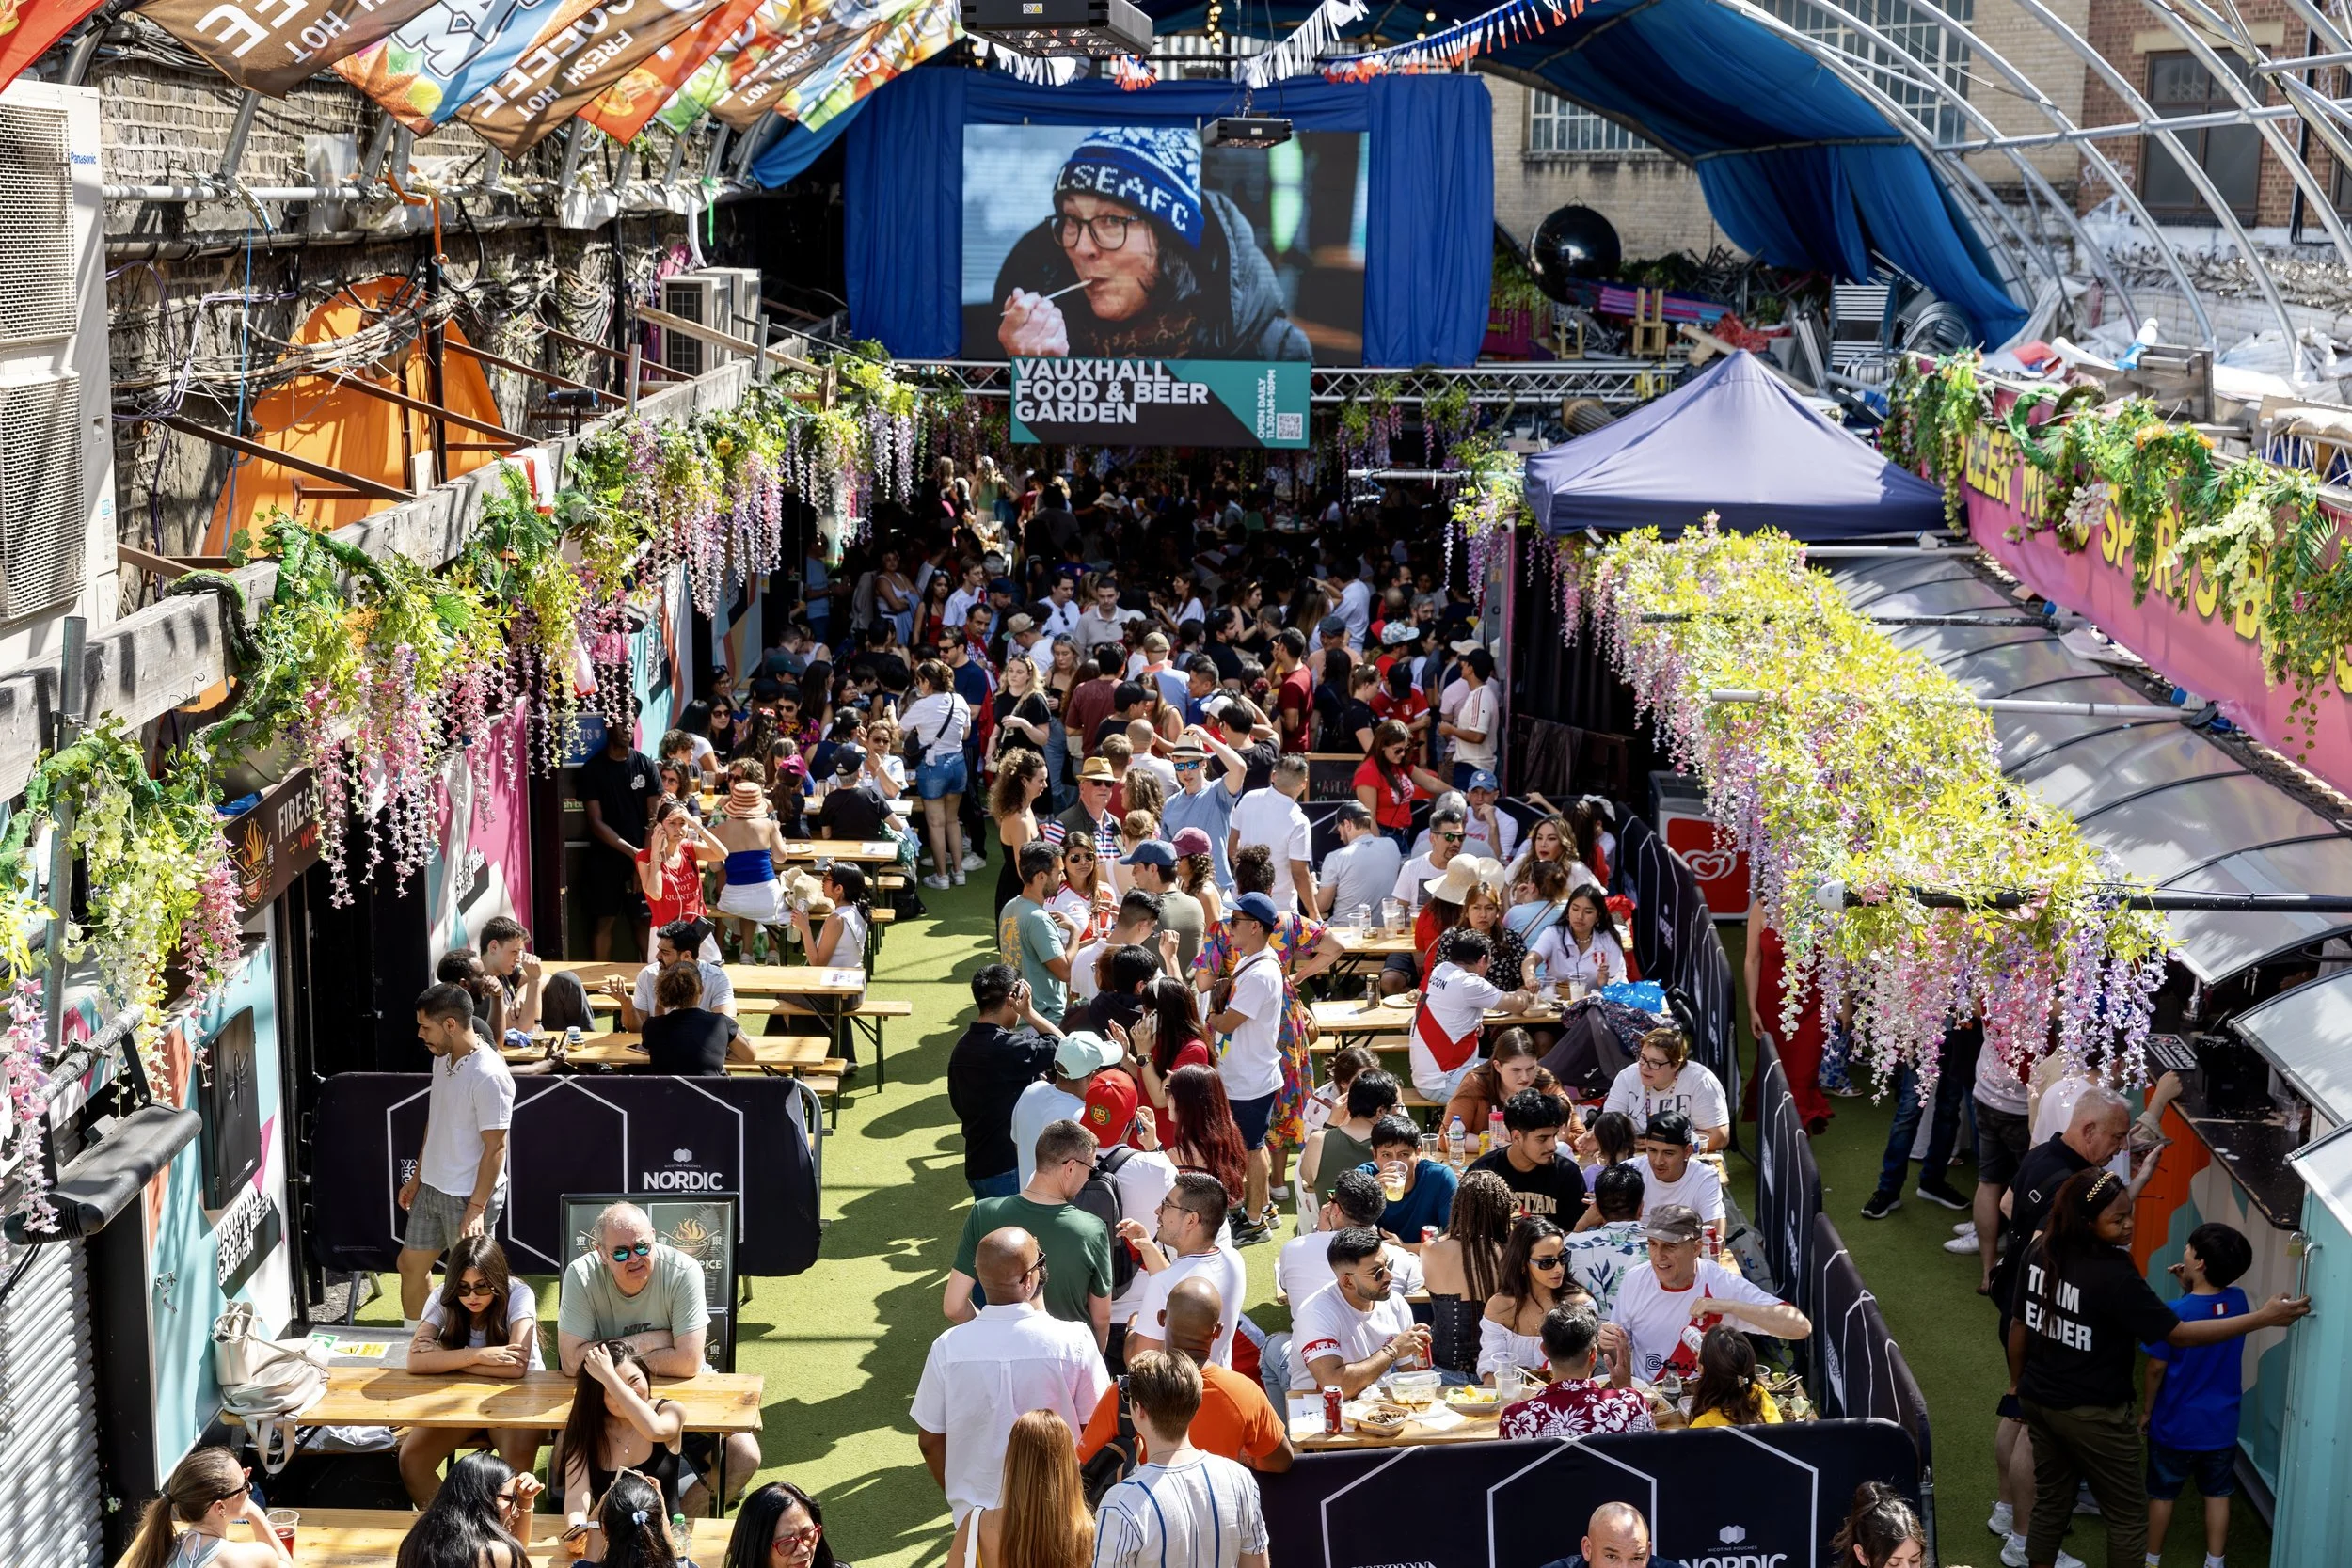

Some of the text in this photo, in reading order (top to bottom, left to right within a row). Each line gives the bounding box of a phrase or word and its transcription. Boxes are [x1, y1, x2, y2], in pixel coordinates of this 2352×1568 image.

[284, 10, 350, 63] HOT
[562, 29, 634, 87] FRESH
[740, 41, 821, 107] FRESH HOT
[516, 85, 561, 122] HOT
[71, 151, 96, 165] Panasonic
[1014, 358, 1170, 382] VAUXHALL
[1015, 380, 1209, 404] FOOD & BEER
[1014, 402, 1137, 423] GARDEN
[1256, 377, 1266, 439] OPEN DAILY
[2100, 483, 2219, 618] SPRS
[278, 792, 305, 843] FIRE
[643, 1171, 723, 1191] NORDIC
[215, 1187, 262, 1247] VAUXHALL
[216, 1227, 242, 1268] FOOD
[250, 1193, 272, 1231] BEER
[217, 1231, 254, 1287] GARDEN
[699, 1259, 723, 1270] PICE
[2027, 1264, 2080, 1314] TM
[2025, 1300, 2092, 1352] EADER
